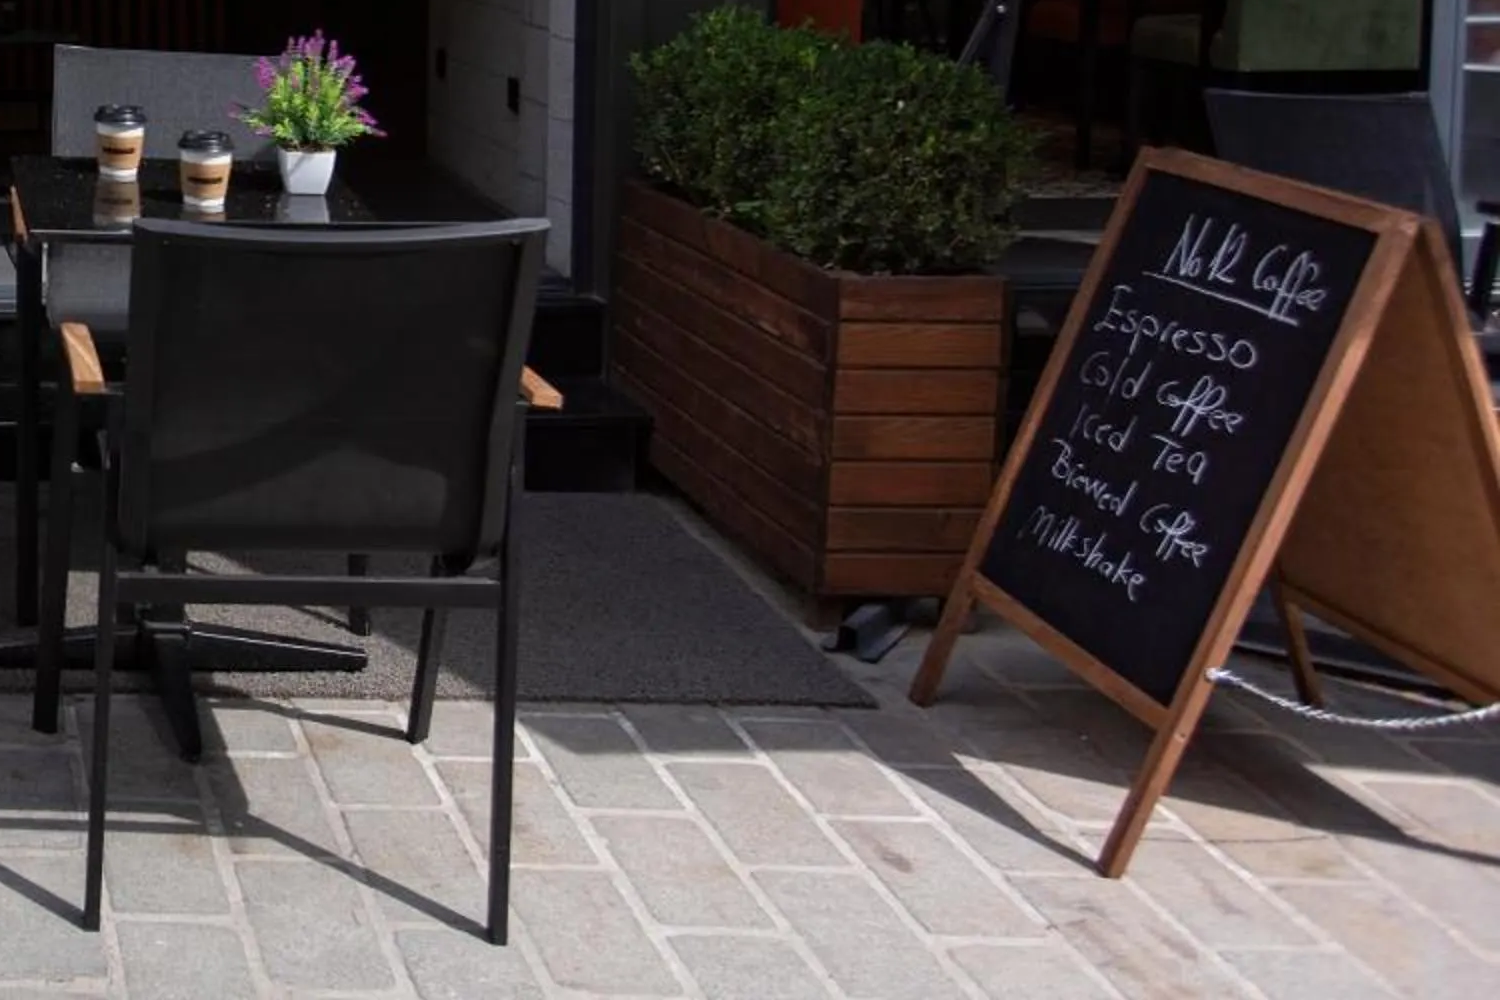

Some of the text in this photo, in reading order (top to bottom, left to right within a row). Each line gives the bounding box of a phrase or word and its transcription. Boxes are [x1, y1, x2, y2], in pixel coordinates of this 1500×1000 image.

[1252, 244, 1327, 319] Coffee
[1093, 284, 1258, 370] Espresso
[1080, 351, 1243, 437] Cold Coffee
[1069, 403, 1207, 485] Iced Tea
[1139, 503, 1209, 569] Coffee
